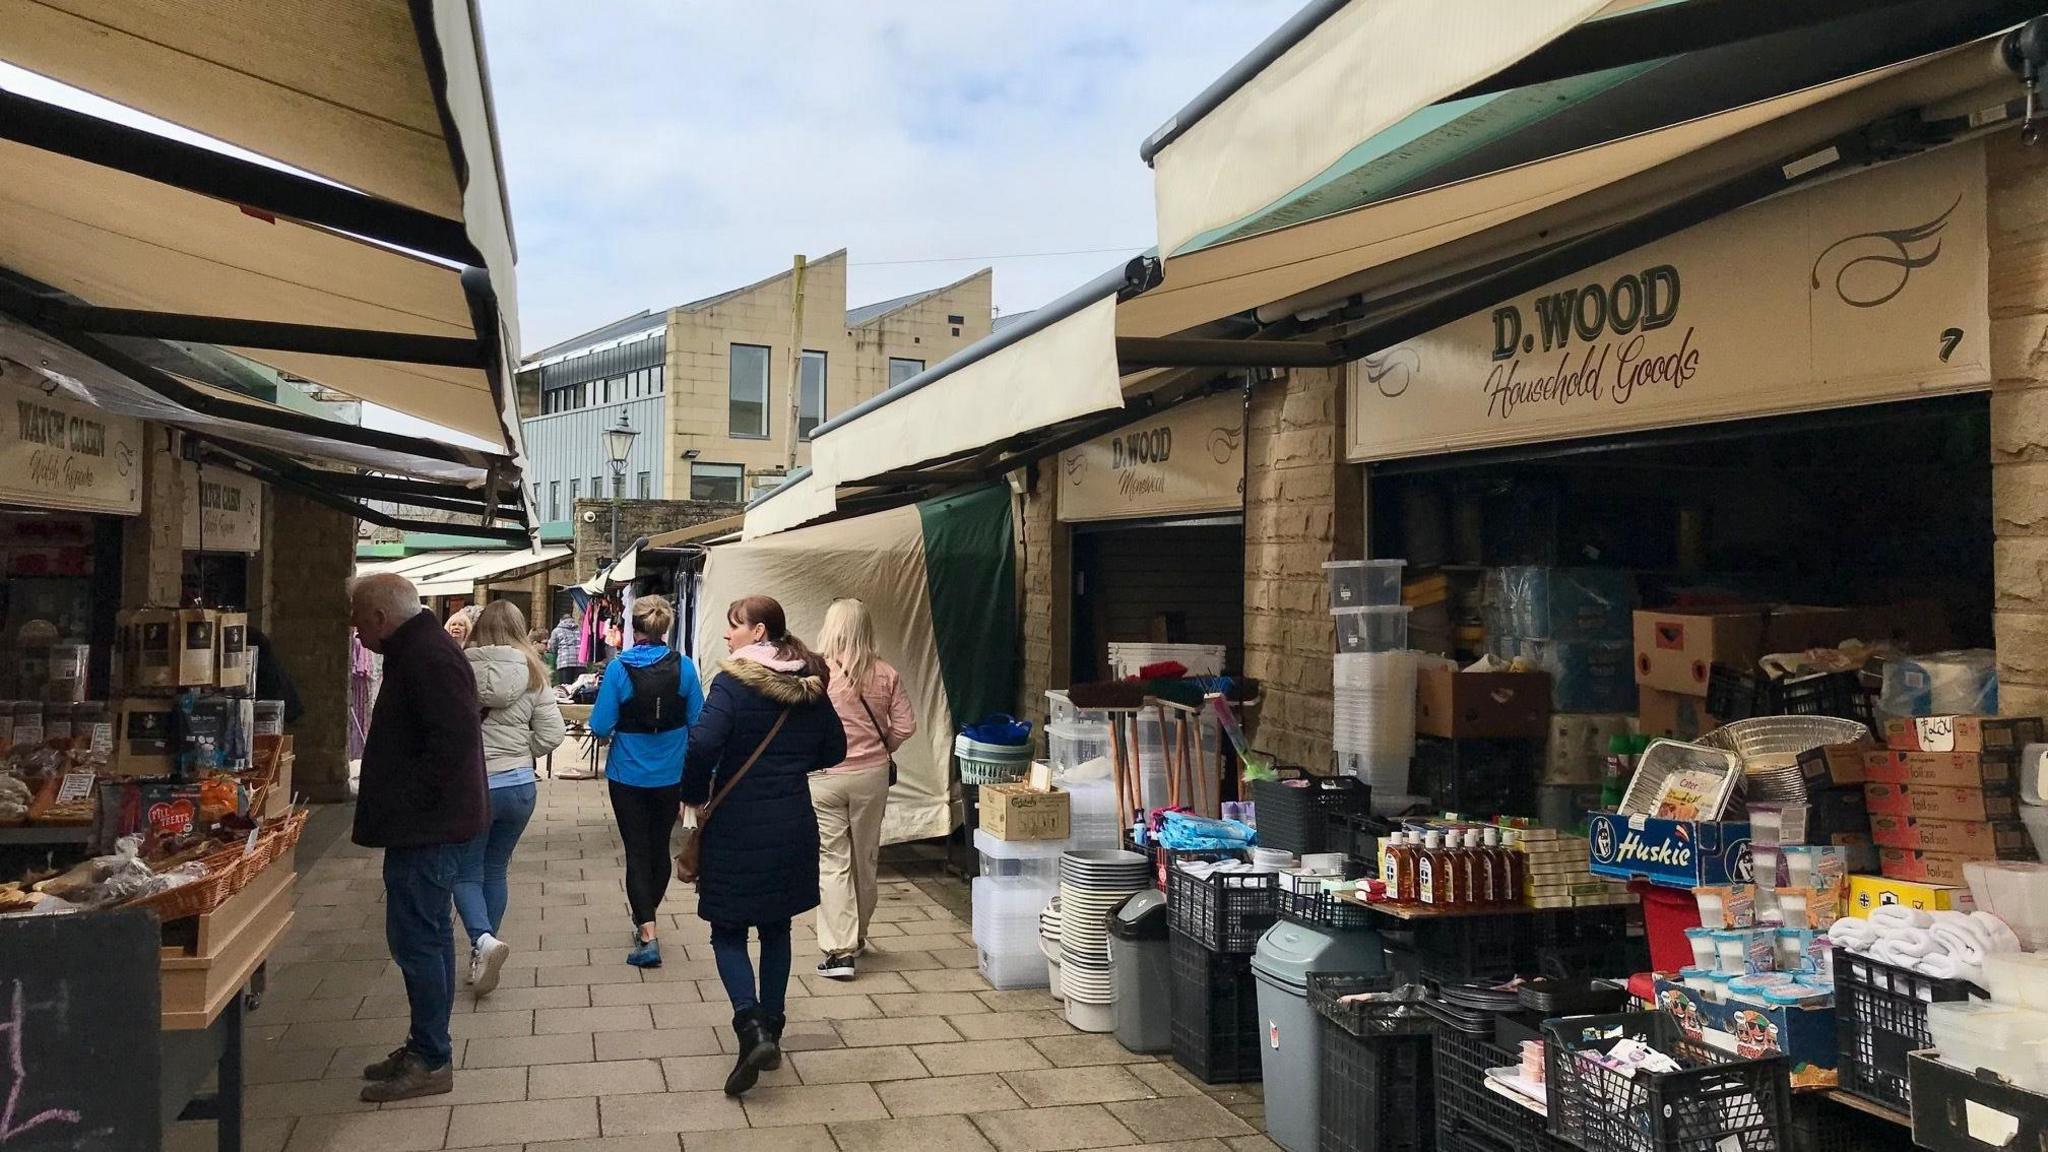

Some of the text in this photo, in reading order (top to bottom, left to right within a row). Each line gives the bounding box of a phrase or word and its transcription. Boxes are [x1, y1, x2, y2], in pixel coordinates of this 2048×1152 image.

[1492, 264, 1681, 362] D.WOOD
[1938, 326, 1965, 364] 7
[1483, 326, 1699, 419] Household Goods
[17, 401, 65, 450] WATCH
[151, 808, 170, 820] PILL
[161, 813, 190, 828] TREATS
[1616, 831, 1691, 867] Huskie
